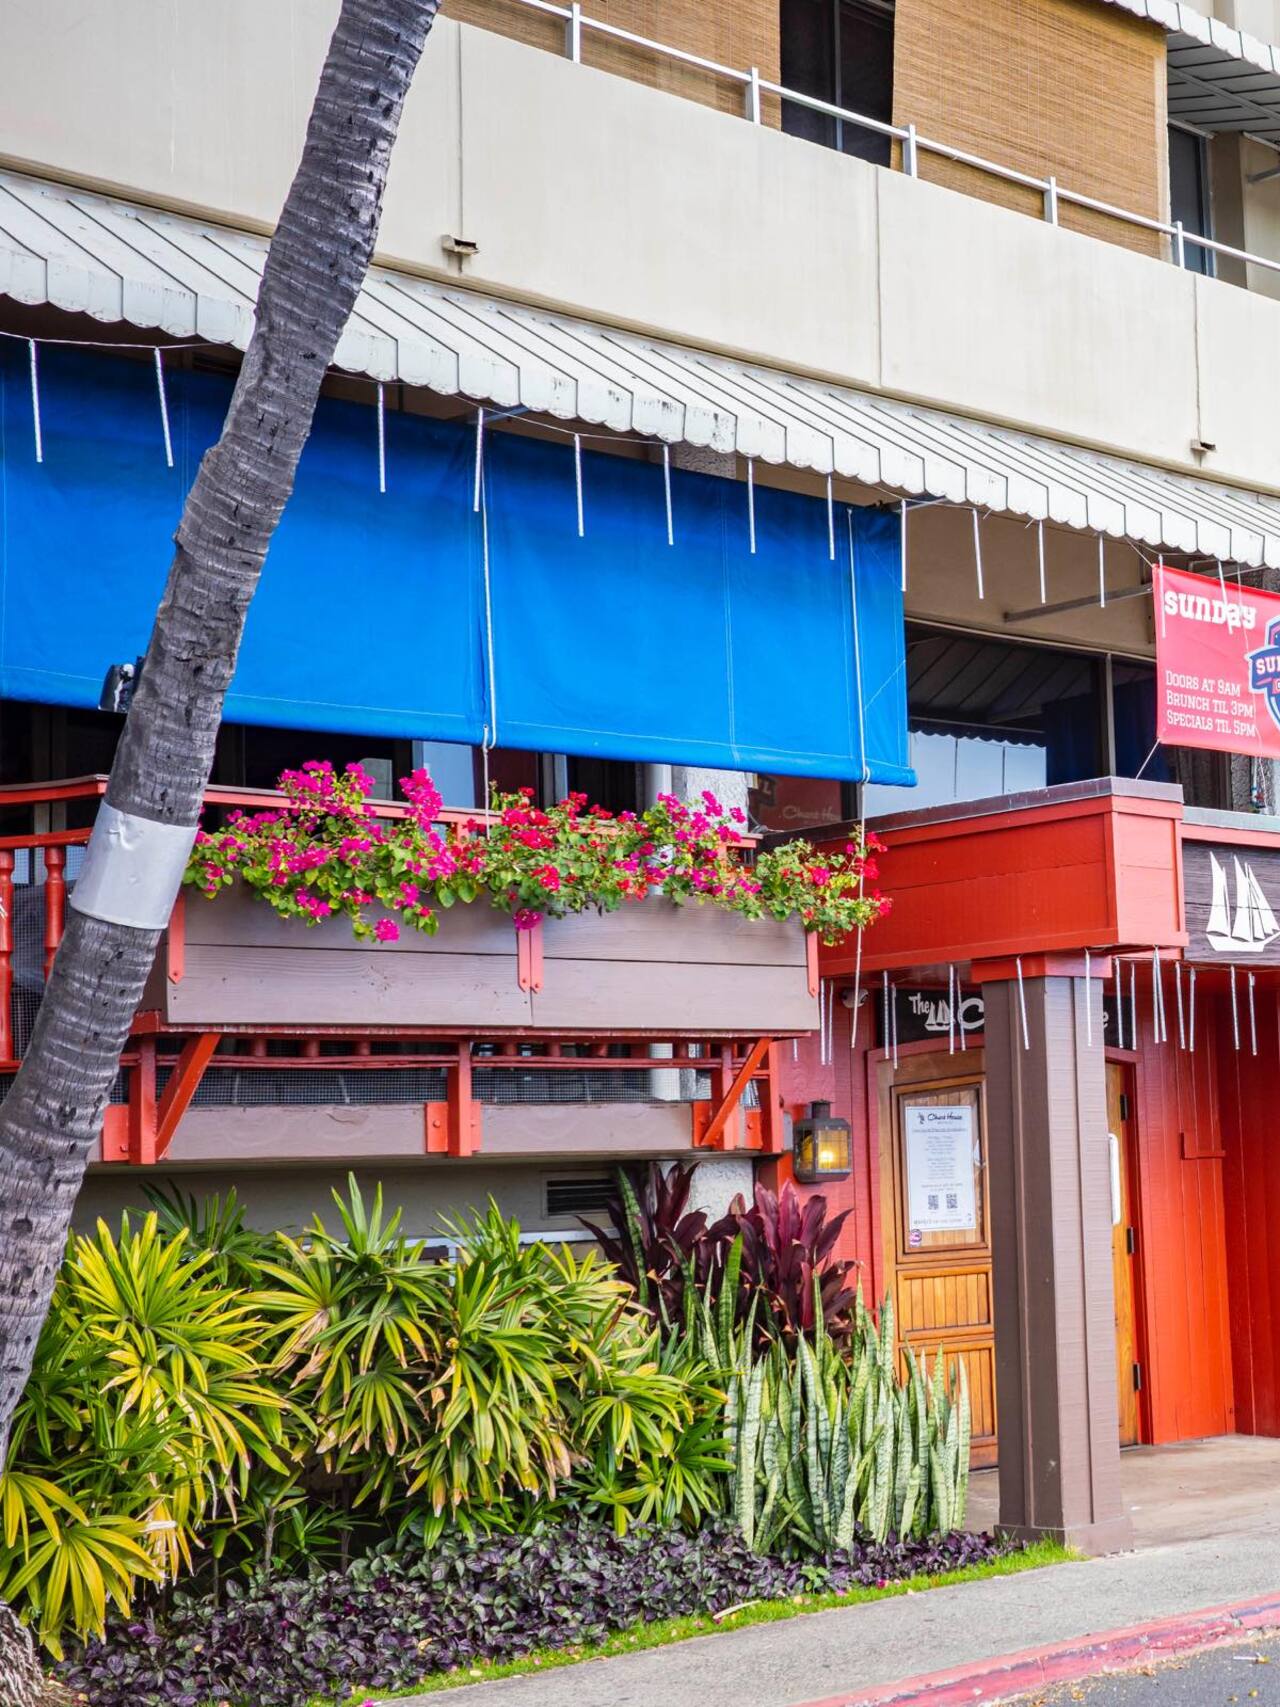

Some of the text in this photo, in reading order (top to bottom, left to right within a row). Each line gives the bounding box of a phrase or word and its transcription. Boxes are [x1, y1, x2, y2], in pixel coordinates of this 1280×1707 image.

[1165, 670, 1241, 697] DOORS AT 9AM
[1166, 690, 1254, 718] BRUNCH TIL 3PM
[1167, 710, 1256, 737] SPECIALS TIL 5PM
[908, 992, 930, 1015] The
